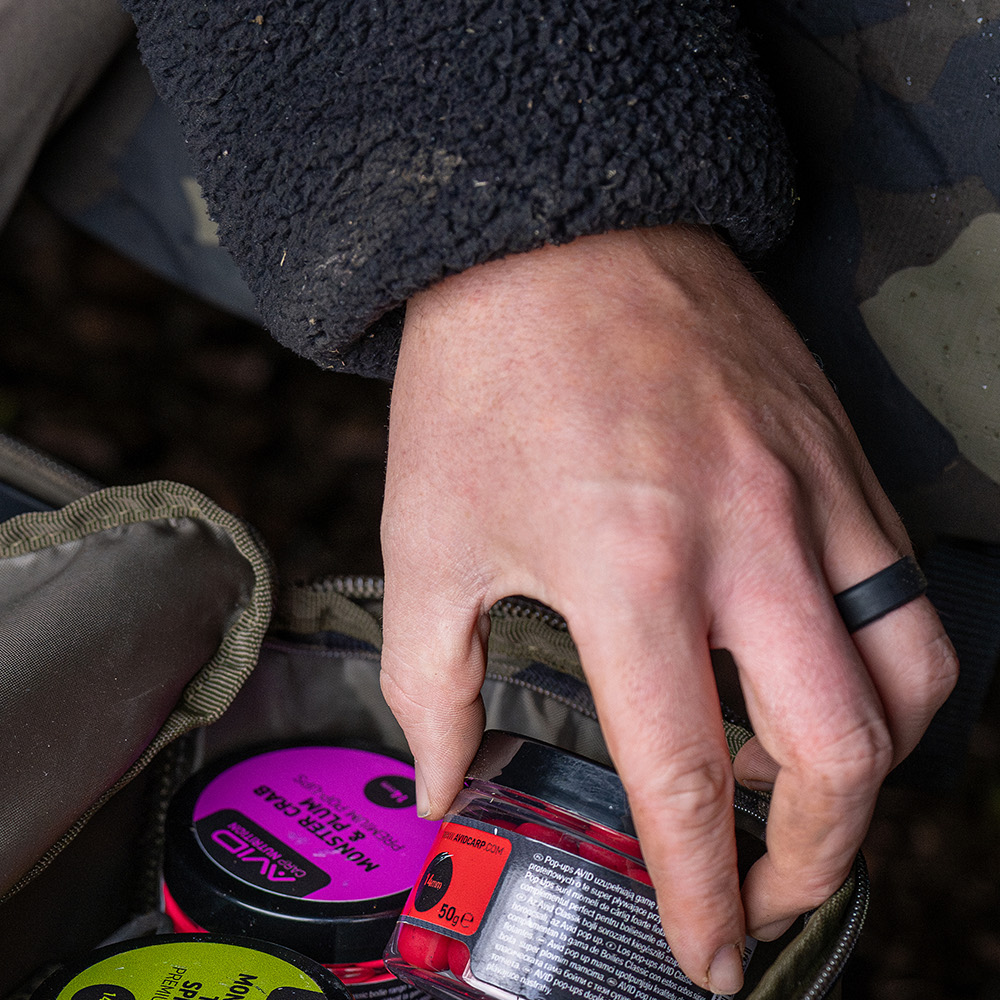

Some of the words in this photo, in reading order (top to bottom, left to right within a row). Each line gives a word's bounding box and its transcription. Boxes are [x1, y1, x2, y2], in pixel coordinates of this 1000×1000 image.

[253, 785, 300, 817] CRAB
[299, 797, 350, 832] PLUM
[227, 822, 283, 861] NUTRITION
[298, 816, 380, 872] MONSTER
[346, 810, 405, 852] PREMIUM
[349, 831, 365, 842] &
[211, 829, 297, 882] AVID
[278, 859, 307, 878] CARP
[544, 855, 574, 874] Pop-ups
[574, 867, 594, 881] AVID
[424, 873, 442, 890] 14mm
[527, 863, 575, 885] proteinowych
[582, 883, 590, 892] te
[590, 887, 612, 900] super
[520, 883, 569, 907] complementul
[569, 902, 595, 918] perfect
[594, 913, 620, 928] pentru
[656, 939, 667, 949] din
[556, 884, 571, 896] sunt
[572, 892, 599, 907] momeli
[599, 902, 610, 911] de
[630, 915, 651, 930] foarte
[550, 918, 560, 926] az
[560, 921, 578, 934] Avid
[576, 930, 592, 940] pop
[593, 935, 604, 946] up.
[617, 945, 631, 956] Los
[631, 952, 657, 969] pop-ups
[657, 963, 674, 976] AVID
[598, 926, 631, 944] sorozatot
[519, 942, 540, 954] super
[539, 950, 568, 966] plovnim
[569, 961, 605, 982] mamcima.
[617, 981, 636, 995] AVID
[547, 940, 565, 952] Avid
[564, 948, 579, 959] pop
[581, 954, 591, 964] up
[590, 958, 615, 973] mamci
[559, 932, 567, 941] la
[567, 938, 589, 951] gama
[589, 946, 599, 955] de
[625, 960, 649, 977] Classic
[649, 973, 661, 982] con
[662, 978, 678, 990] estos
[534, 969, 553, 983] AVID
[553, 979, 583, 996] pop-ups
